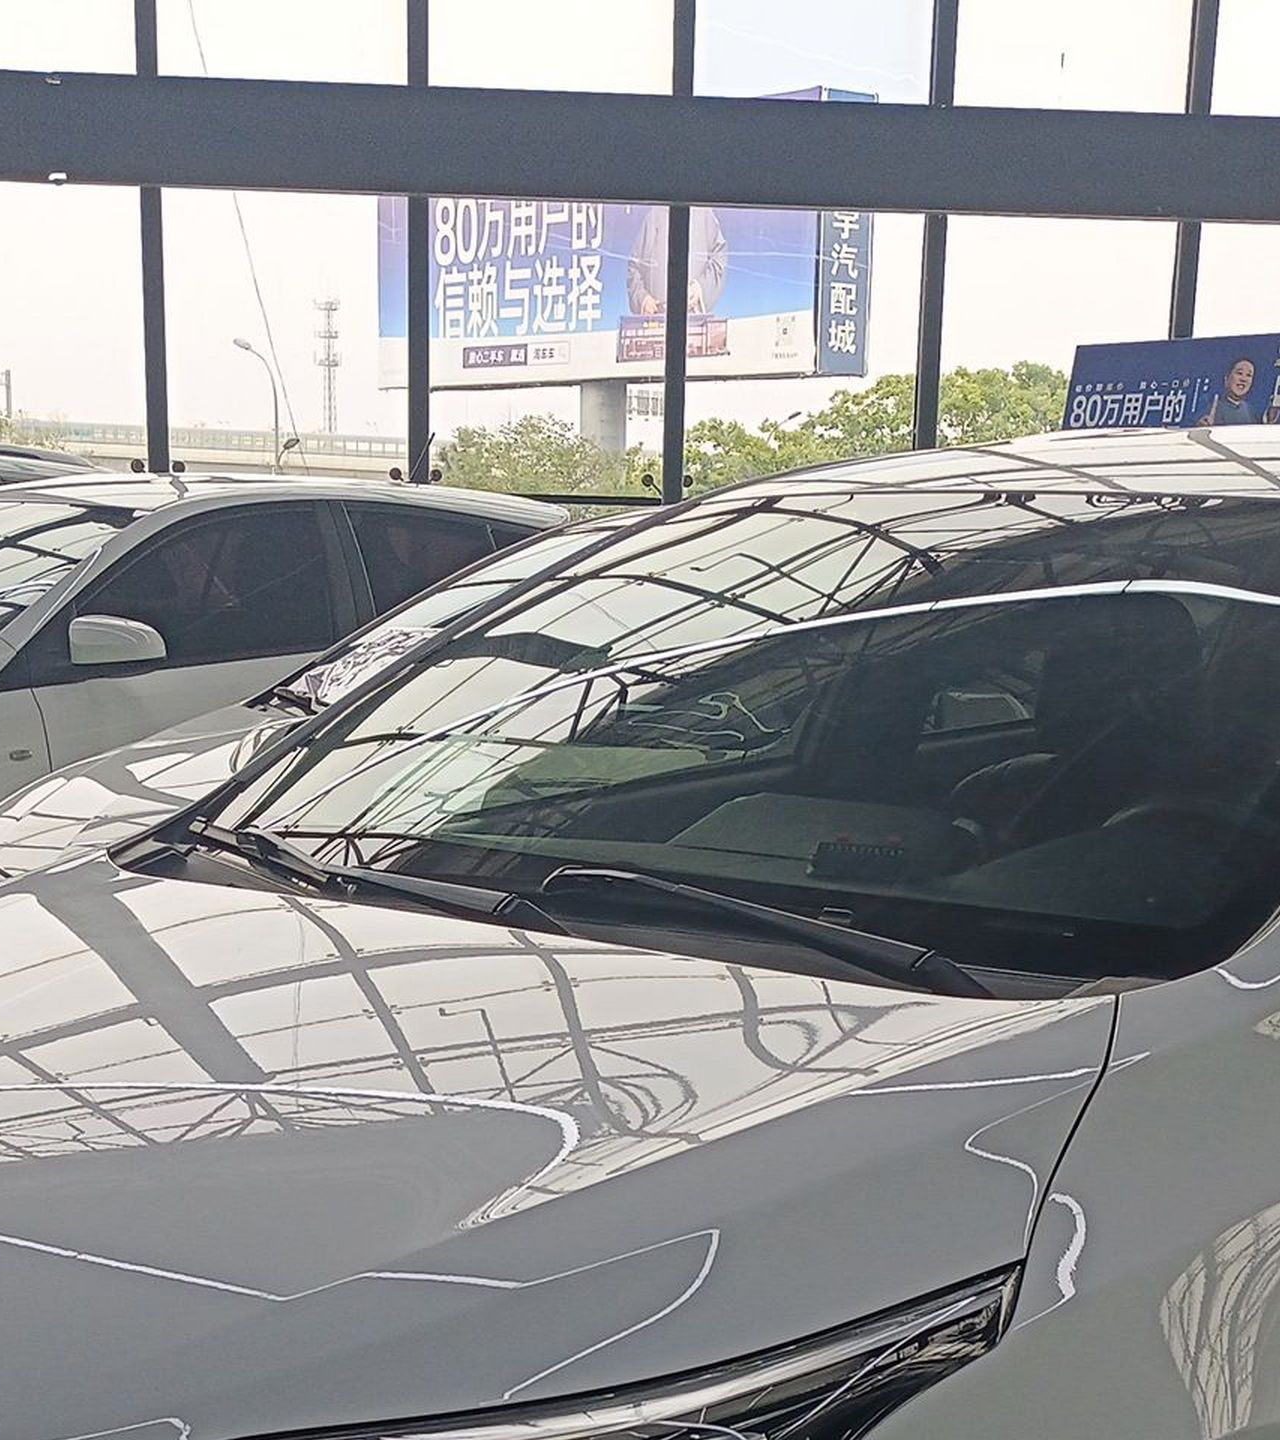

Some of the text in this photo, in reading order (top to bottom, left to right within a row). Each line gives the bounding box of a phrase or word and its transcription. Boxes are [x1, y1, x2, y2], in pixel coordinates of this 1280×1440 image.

[434, 199, 604, 266] 80万用户的
[434, 254, 604, 339] 信赖与选择
[1069, 389, 1187, 428] 80万用户的
